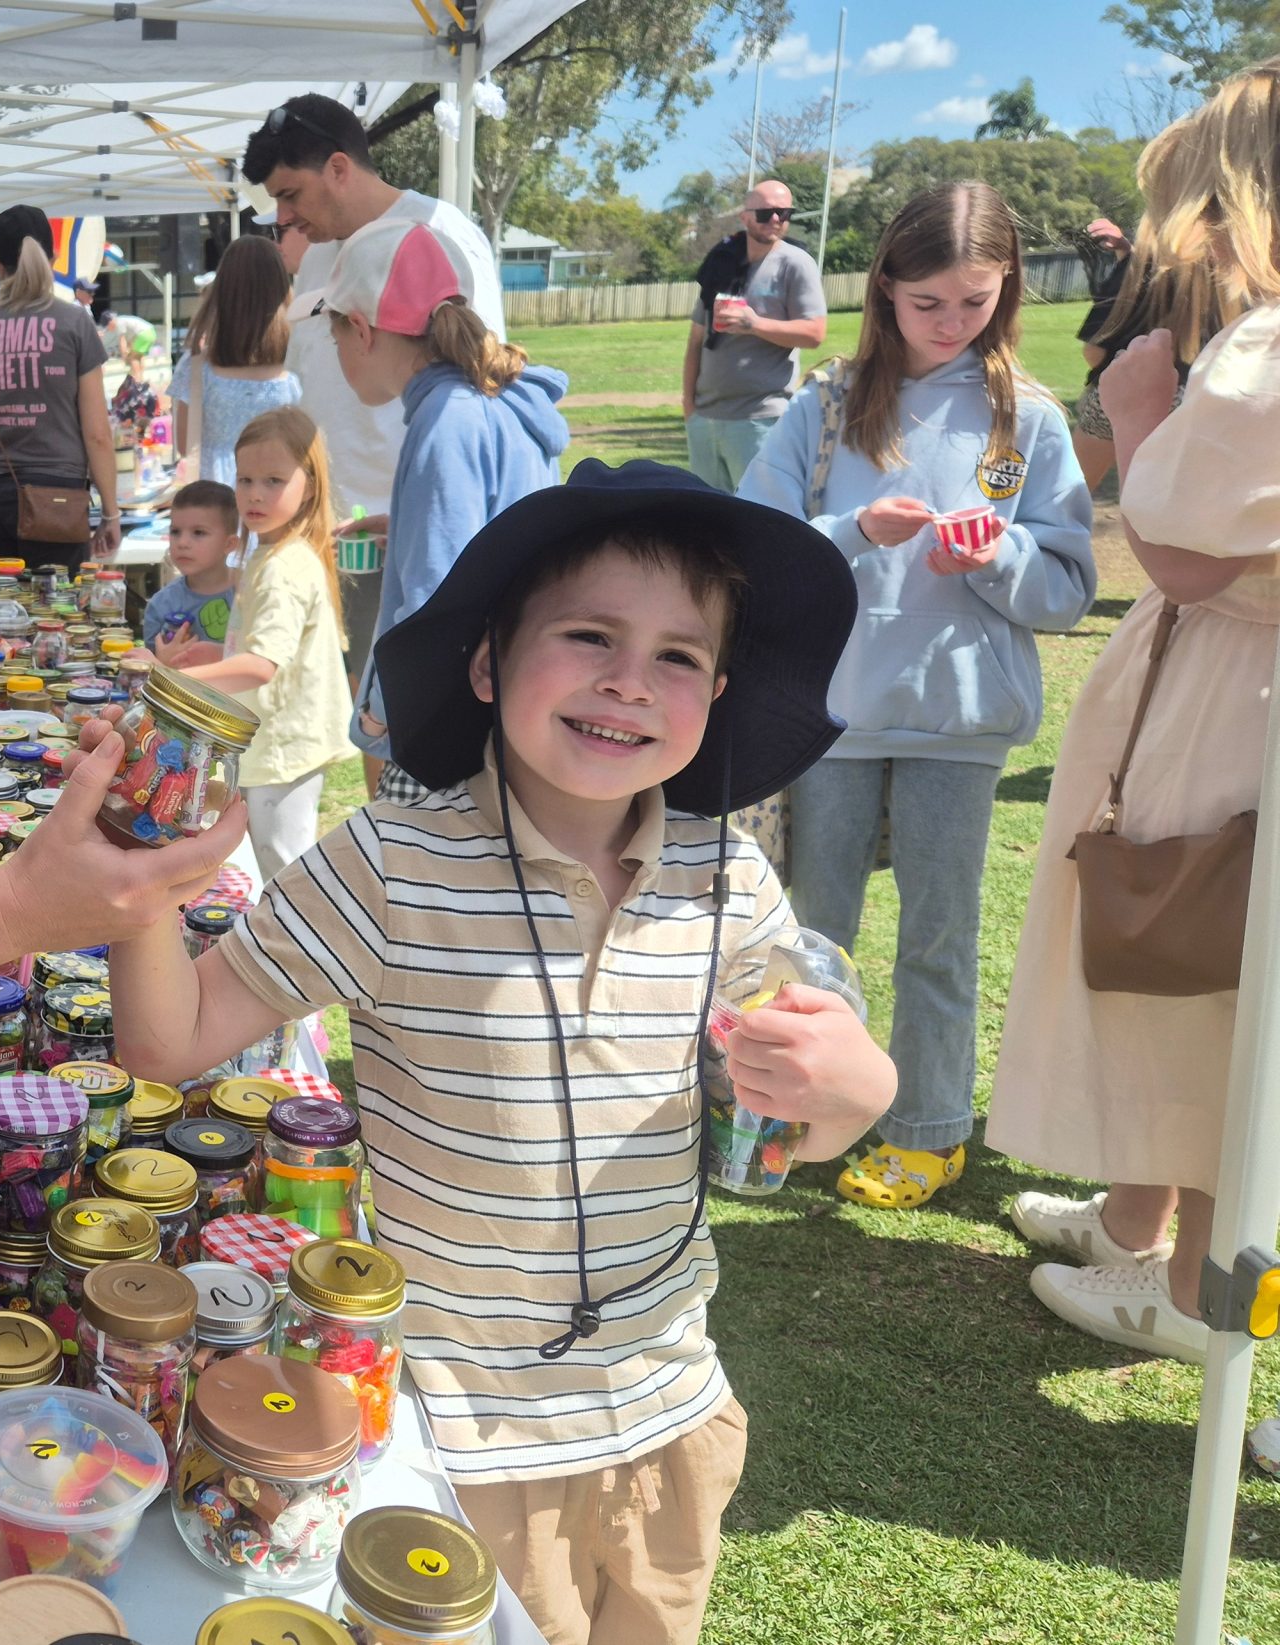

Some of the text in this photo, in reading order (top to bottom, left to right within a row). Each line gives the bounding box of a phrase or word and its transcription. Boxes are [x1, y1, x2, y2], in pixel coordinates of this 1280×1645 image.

[44, 366, 66, 376] TOUR
[976, 453, 1029, 477] NRTH
[982, 468, 1021, 488] WEST
[0, 1050, 15, 1061] Jam
[131, 1158, 183, 1177] 2
[335, 1255, 374, 1278] 2
[125, 1279, 147, 1293] 2
[210, 1283, 254, 1307] 2
[271, 1393, 291, 1411] 2
[25, 1443, 58, 1460] 2
[421, 1559, 441, 1573] 2
